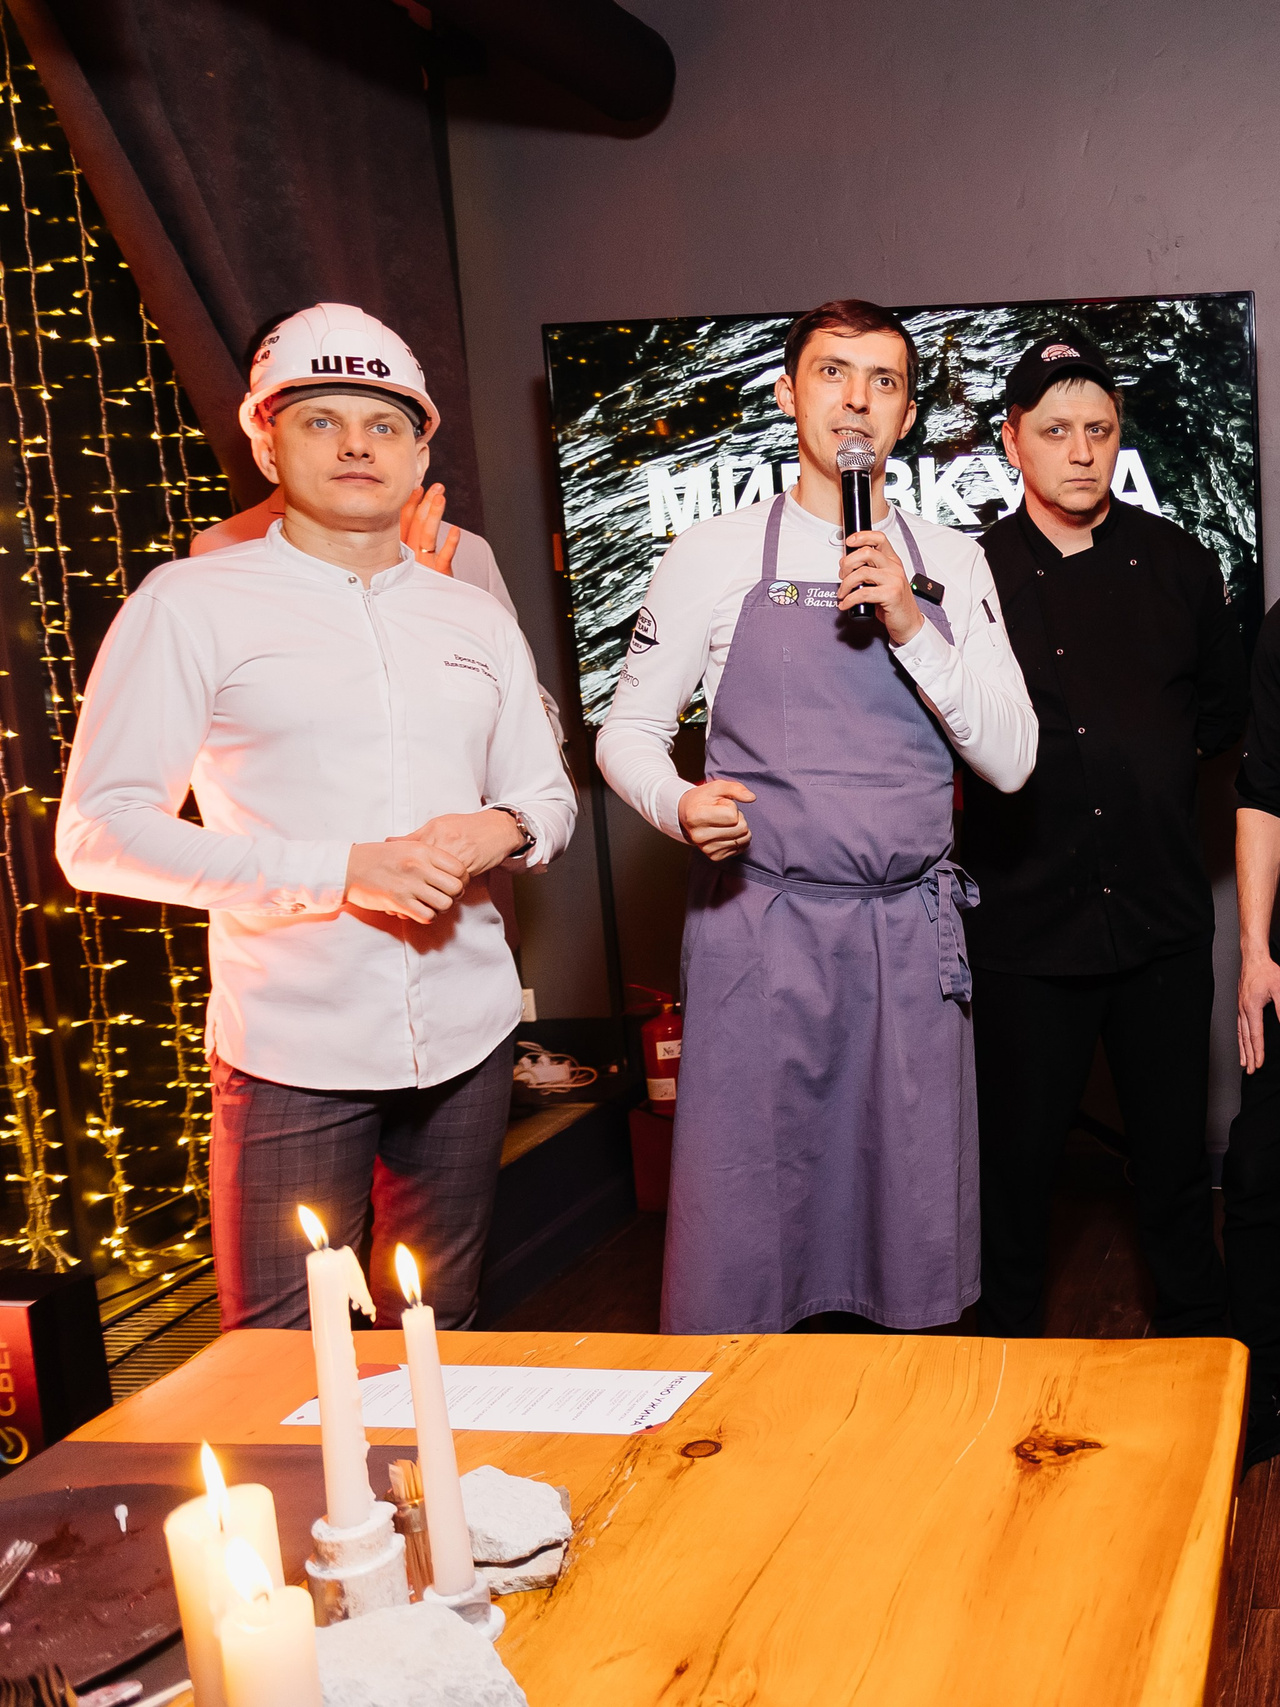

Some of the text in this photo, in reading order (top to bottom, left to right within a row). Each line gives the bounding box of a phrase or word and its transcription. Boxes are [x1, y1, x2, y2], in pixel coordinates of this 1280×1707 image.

[311, 356, 391, 379] ШЕФ
[883, 448, 1163, 526] ВКУА
[806, 587, 838, 598] Паве
[659, 1375, 687, 1396] МЕНЮ
[630, 1397, 665, 1427] УЖИНА
